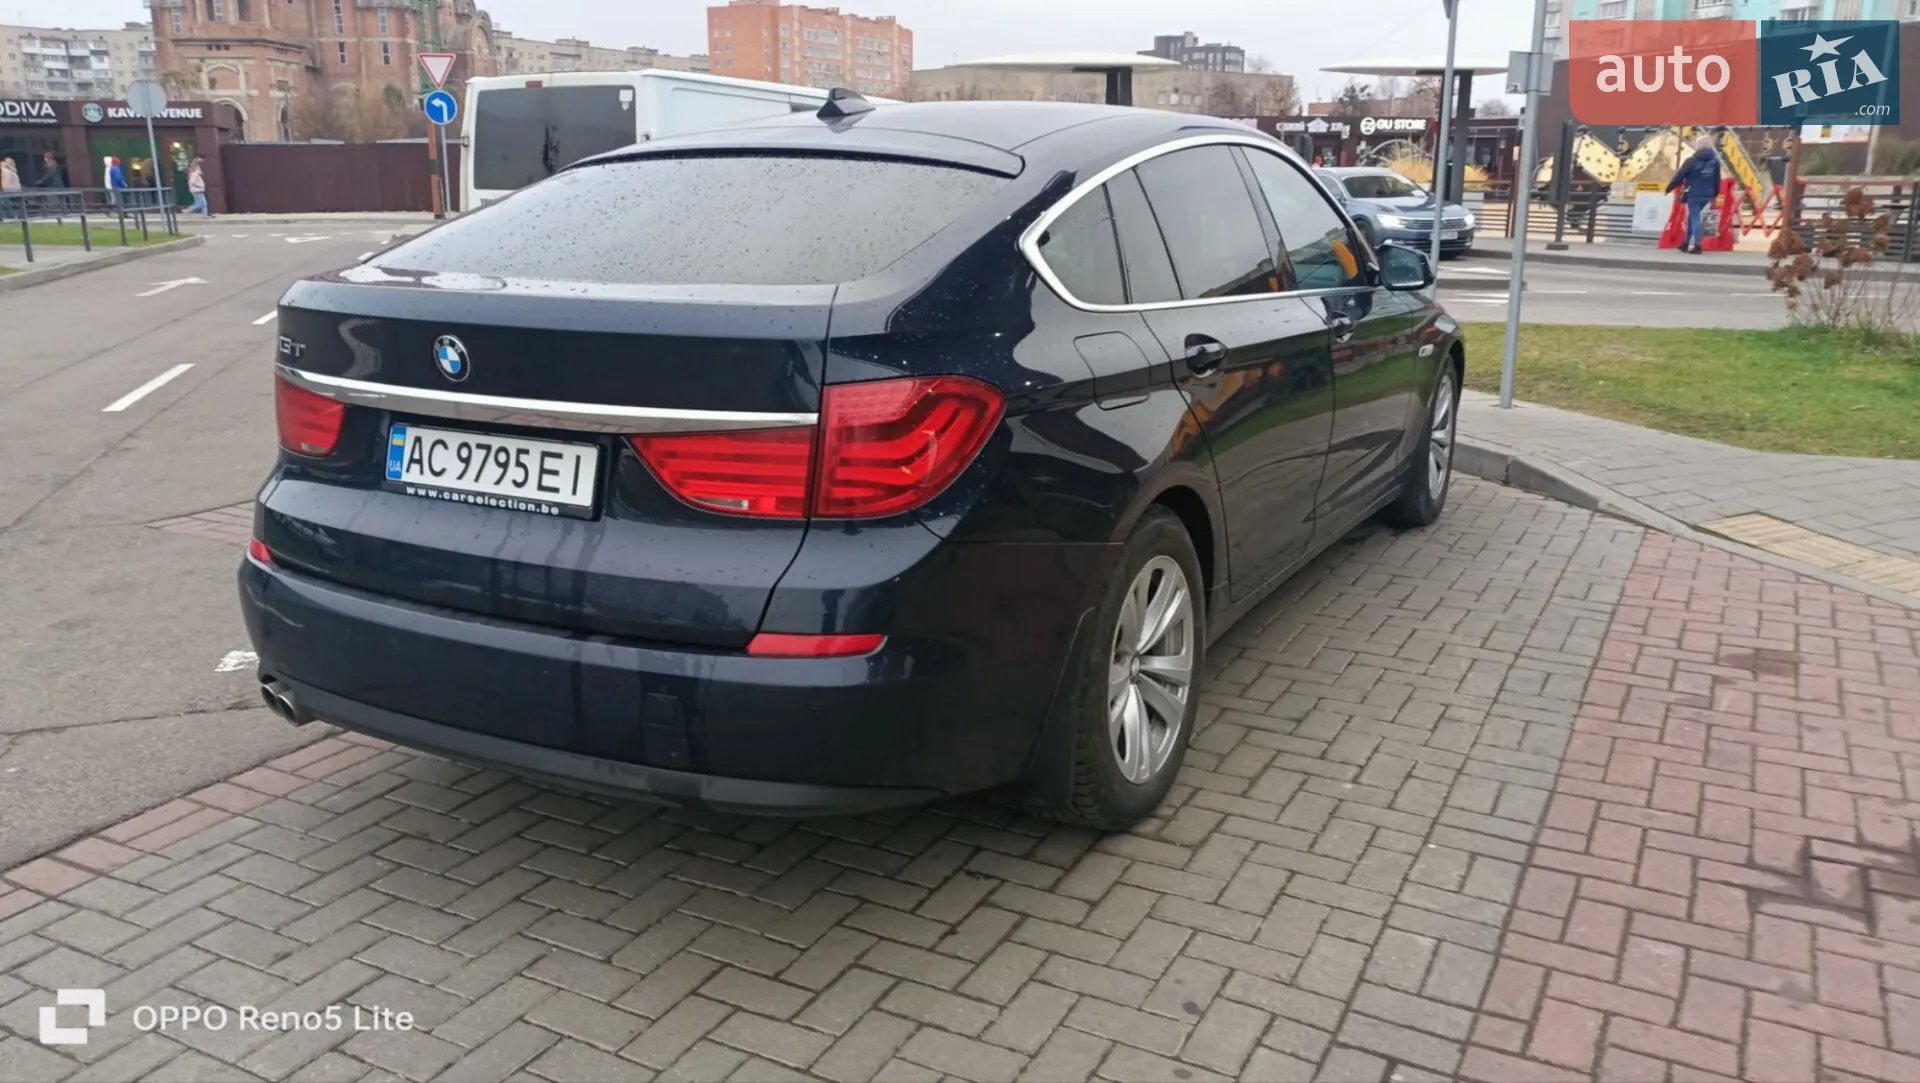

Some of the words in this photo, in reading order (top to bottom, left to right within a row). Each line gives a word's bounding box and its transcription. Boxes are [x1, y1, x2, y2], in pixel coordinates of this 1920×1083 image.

[1394, 119, 1427, 130] STORE
[279, 336, 307, 357] GT
[389, 459, 401, 472] UA
[406, 485, 560, 516] www.carselection.be
